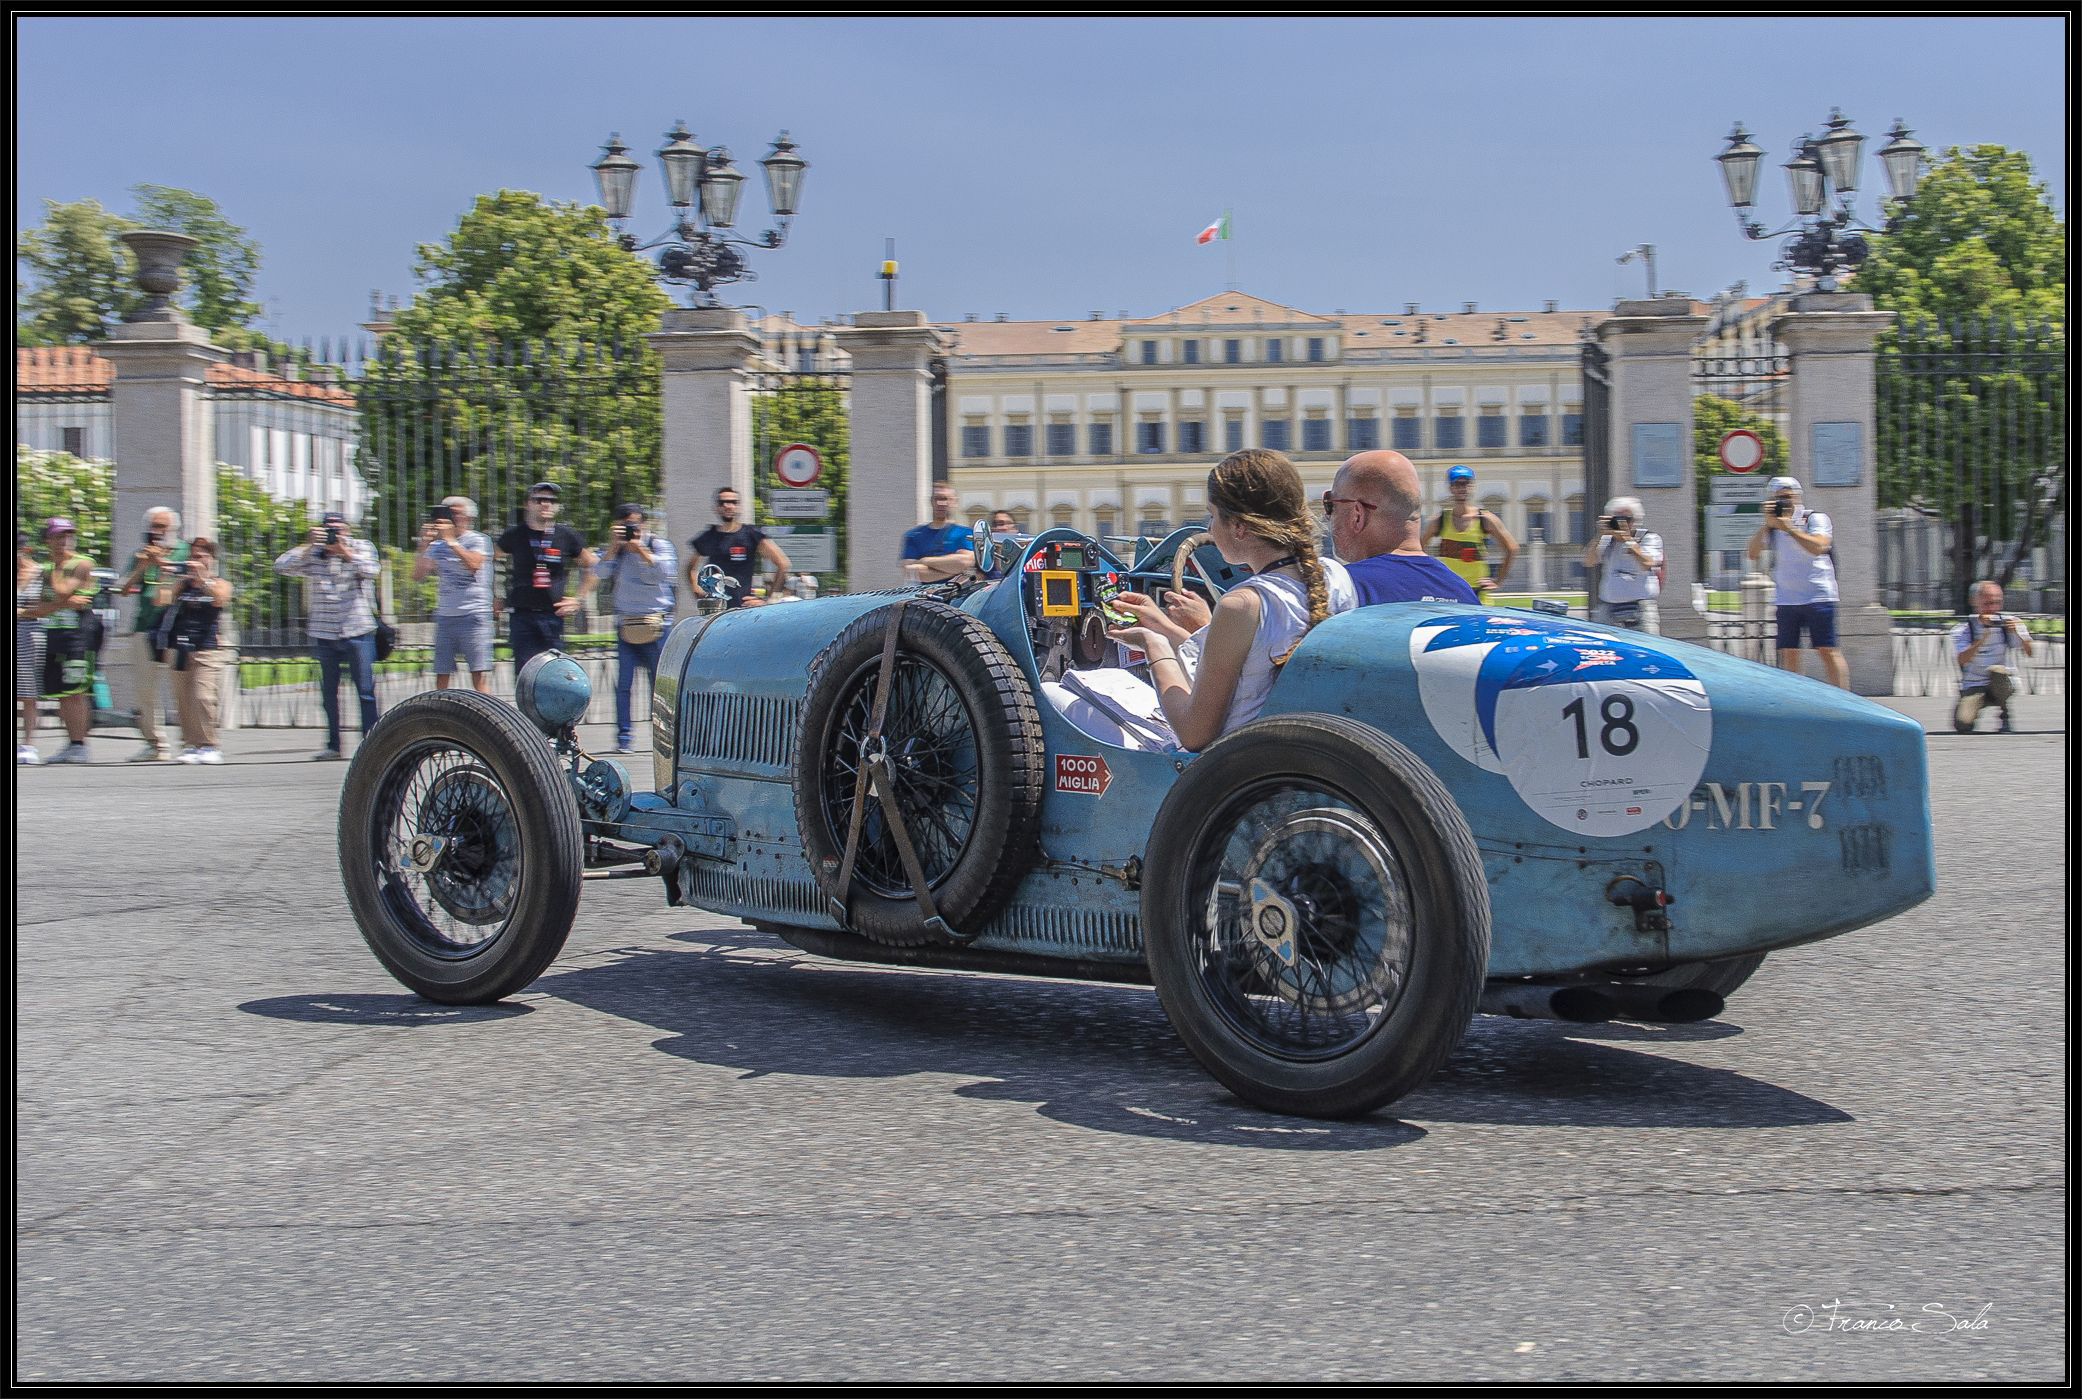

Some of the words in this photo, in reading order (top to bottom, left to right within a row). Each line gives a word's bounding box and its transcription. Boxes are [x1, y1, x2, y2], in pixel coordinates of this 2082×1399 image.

[1562, 693, 1640, 759] 18
[1061, 758, 1097, 773] 1000
[1059, 775, 1100, 790] MIGLIA
[1580, 777, 1633, 788] CHOPARD
